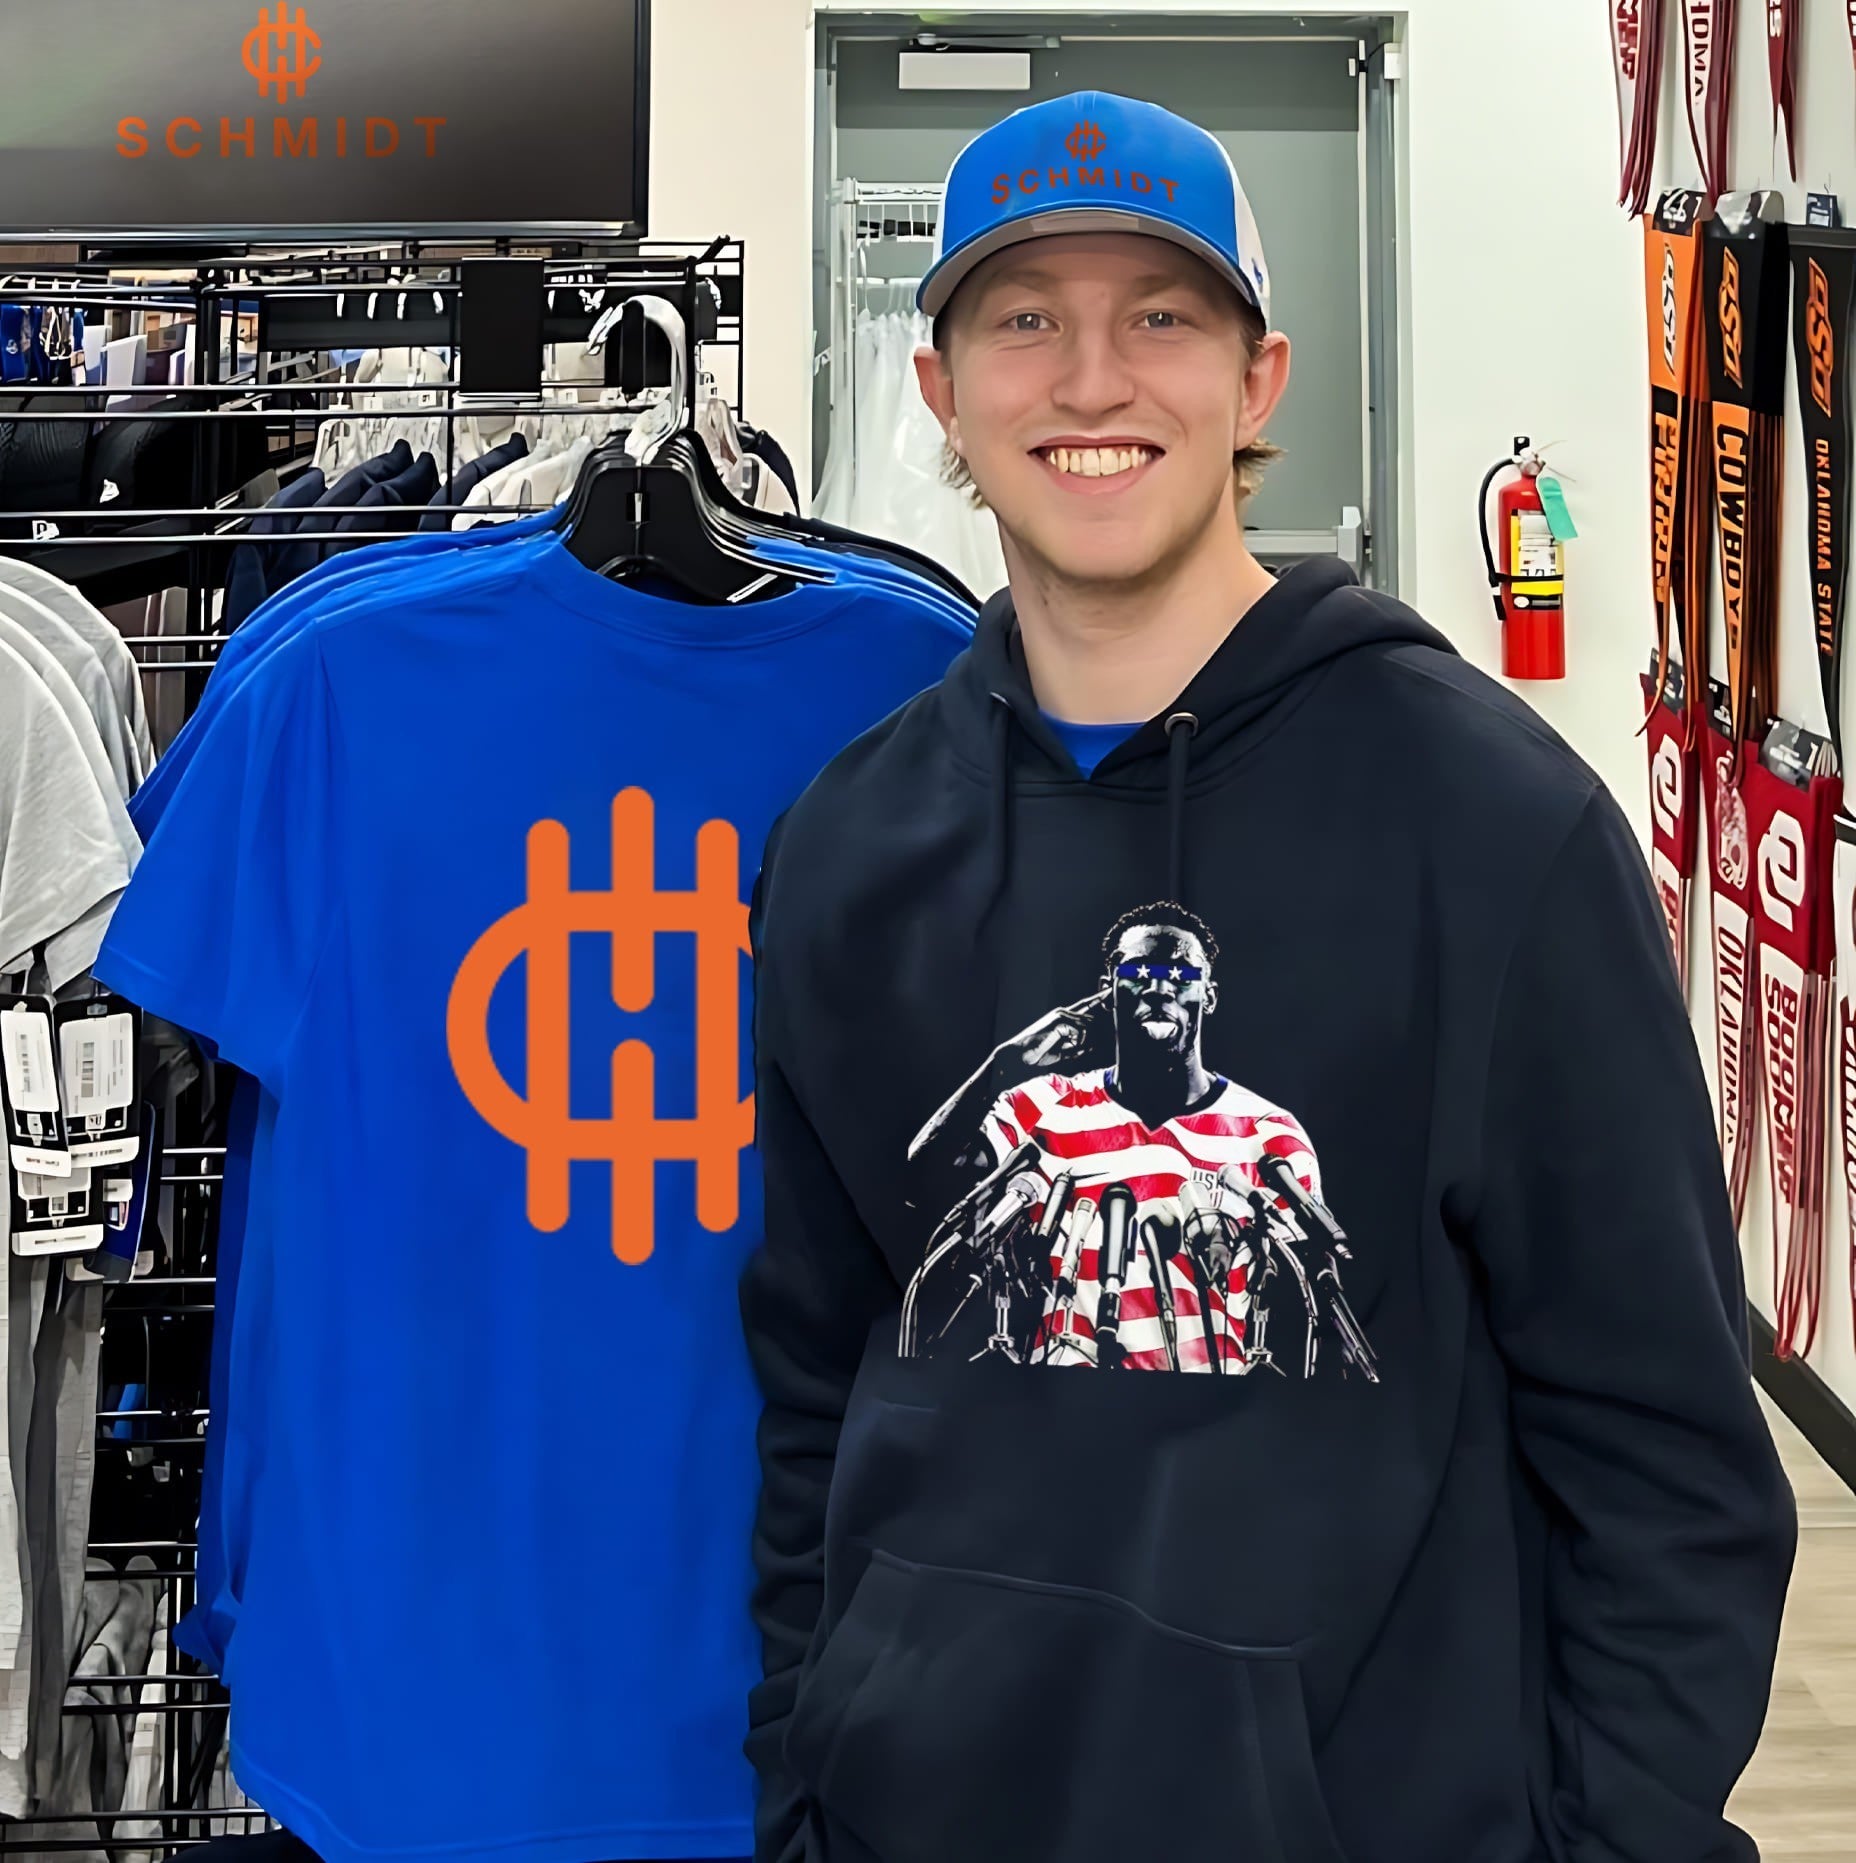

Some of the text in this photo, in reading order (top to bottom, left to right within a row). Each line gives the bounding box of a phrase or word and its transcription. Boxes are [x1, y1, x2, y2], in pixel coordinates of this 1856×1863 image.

[116, 116, 447, 159] SCHMIDT
[991, 167, 1179, 205] SCHMIDT
[1815, 438, 1832, 570] OKLAHOMA
